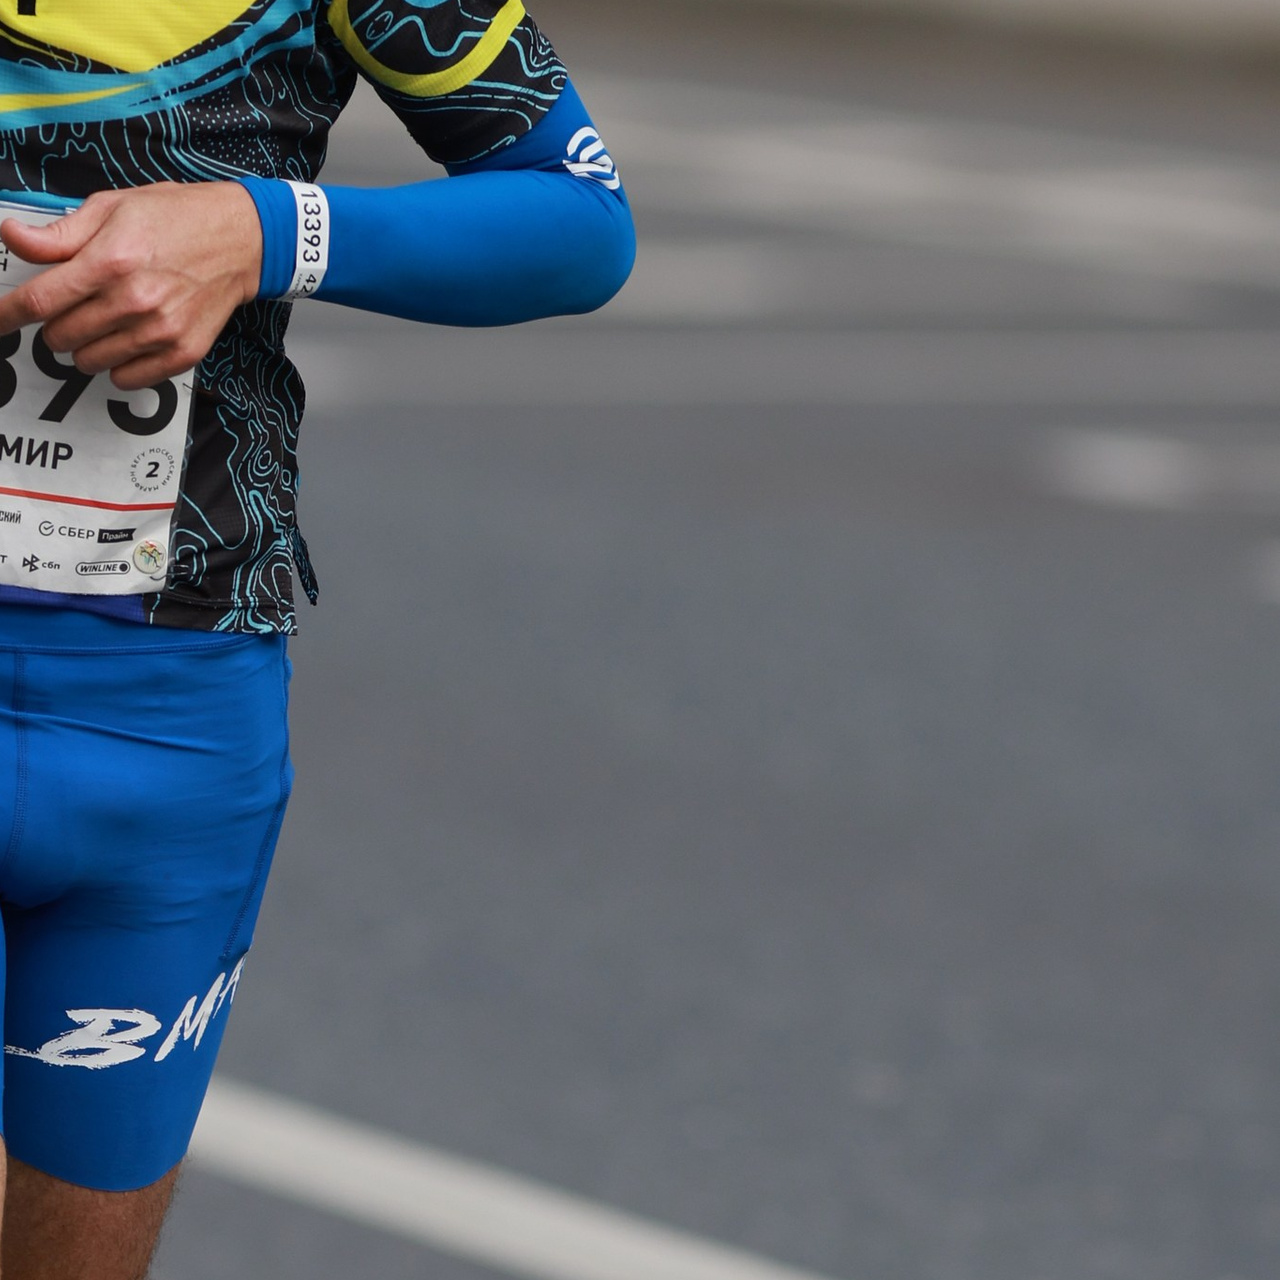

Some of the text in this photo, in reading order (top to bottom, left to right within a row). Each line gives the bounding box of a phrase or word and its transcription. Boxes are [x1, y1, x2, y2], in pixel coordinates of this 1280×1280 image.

[301, 190, 322, 263] 13393
[145, 461, 160, 478] 2
[58, 525, 96, 540] СБЕР
[41, 561, 61, 570] сбп
[80, 563, 118, 573] WINLINE
